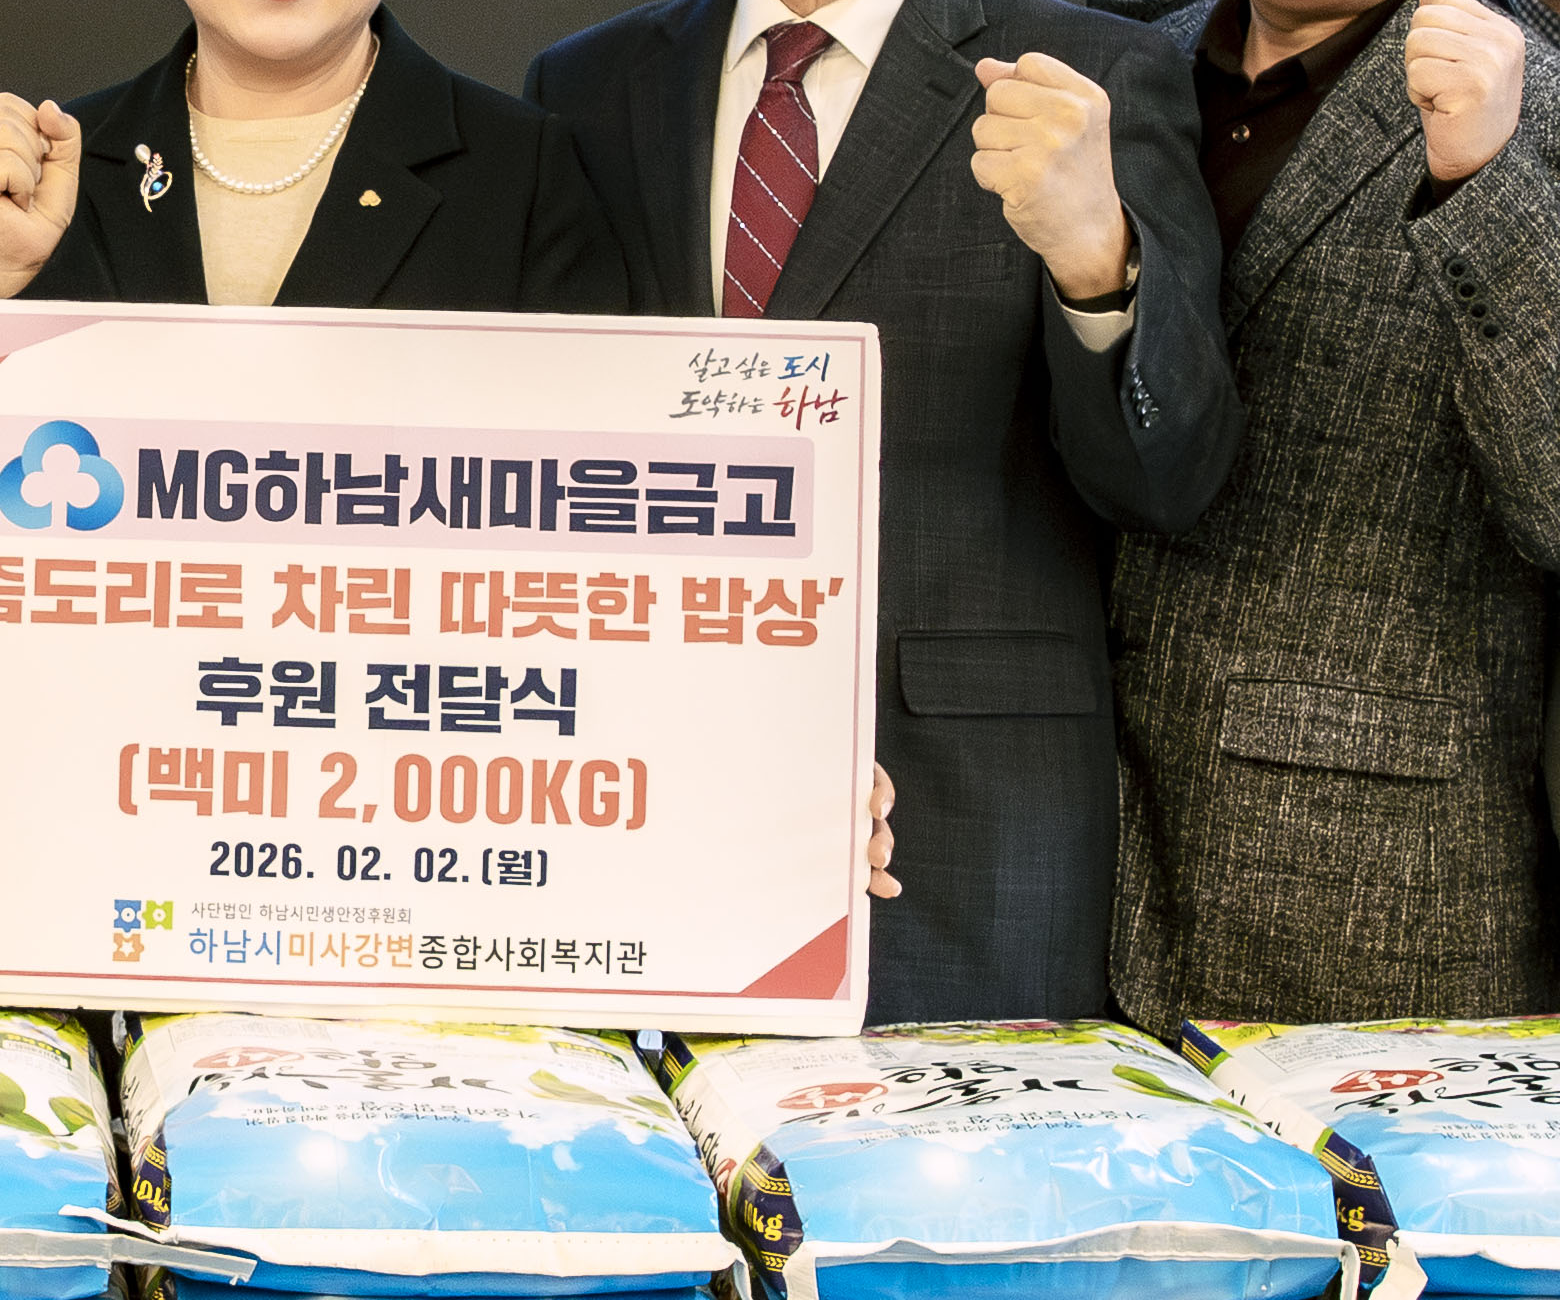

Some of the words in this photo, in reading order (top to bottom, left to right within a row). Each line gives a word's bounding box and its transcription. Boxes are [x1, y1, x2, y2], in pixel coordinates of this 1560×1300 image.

[689, 348, 731, 383] 살고
[735, 352, 772, 380] 싶은
[778, 352, 830, 382] 도시
[669, 389, 764, 419] 도약하는
[773, 385, 849, 430] 하남
[137, 445, 796, 539] MG하남새마을금고
[270, 565, 412, 636] 차린
[440, 568, 657, 643] 따뜻한
[681, 575, 846, 648] 밥상'
[195, 656, 337, 729] 후원
[364, 662, 580, 737] 전달식
[117, 742, 290, 822] (백미
[209, 840, 317, 882] 2026.
[336, 843, 392, 883] 02.
[191, 902, 253, 921] 사단법인
[258, 903, 412, 927] 하남시민생안정후원회
[187, 927, 647, 976] 하남시미사강변종합사회복지관
